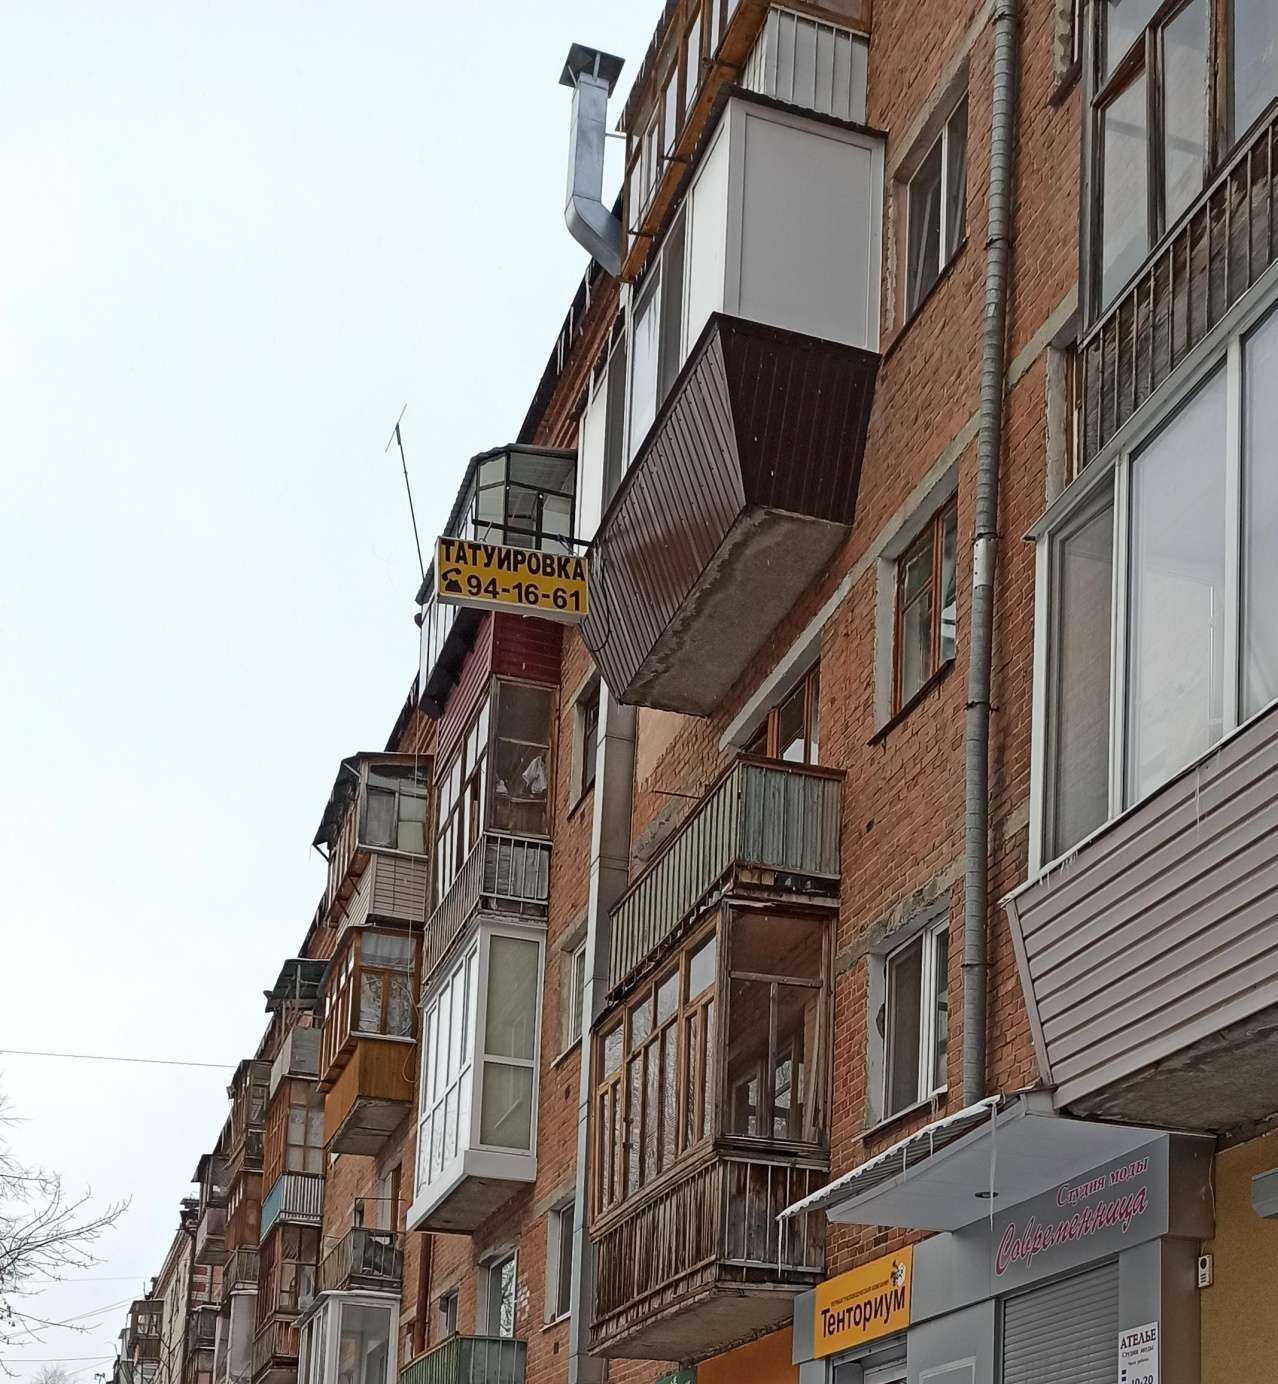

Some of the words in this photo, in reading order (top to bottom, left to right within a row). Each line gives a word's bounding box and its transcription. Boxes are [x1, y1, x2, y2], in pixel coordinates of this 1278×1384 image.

[441, 539, 586, 581] ТАТУИРОВКА
[466, 574, 580, 611] 94-16-61
[1057, 1183, 1106, 1207] Студия
[1110, 1157, 1150, 1185] моды
[995, 1185, 1148, 1276] Современница
[821, 1286, 905, 1338] Тенториум
[1120, 1329, 1156, 1349] АТЕЛЬЕ
